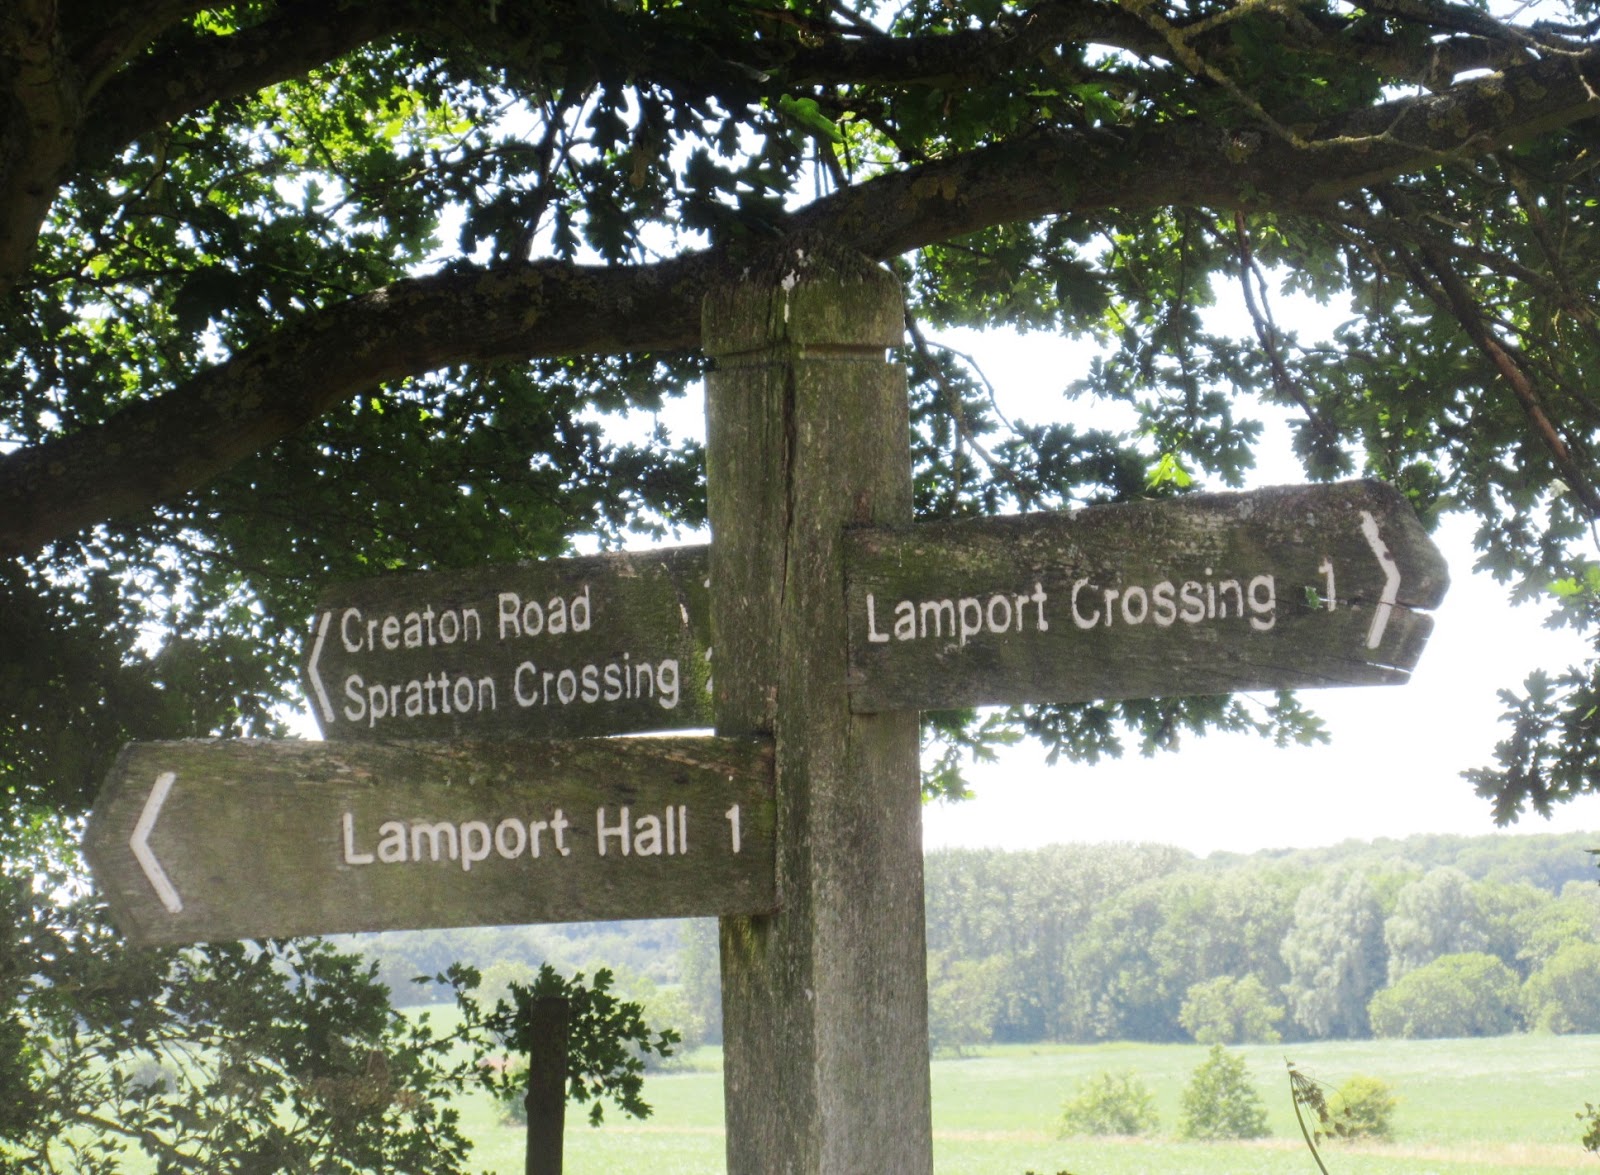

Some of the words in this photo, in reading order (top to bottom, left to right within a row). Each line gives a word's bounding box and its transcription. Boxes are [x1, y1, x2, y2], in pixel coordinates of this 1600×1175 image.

[340, 604, 481, 653] Creaton
[498, 585, 591, 640] Road
[866, 581, 1049, 645] Lamport
[1071, 567, 1277, 631] Crossing
[1318, 557, 1337, 612] 1
[343, 671, 497, 728] Spratton
[513, 652, 680, 709] Crossing
[342, 808, 571, 871] Lamport
[596, 805, 688, 857] Hall
[725, 804, 741, 854] 1
